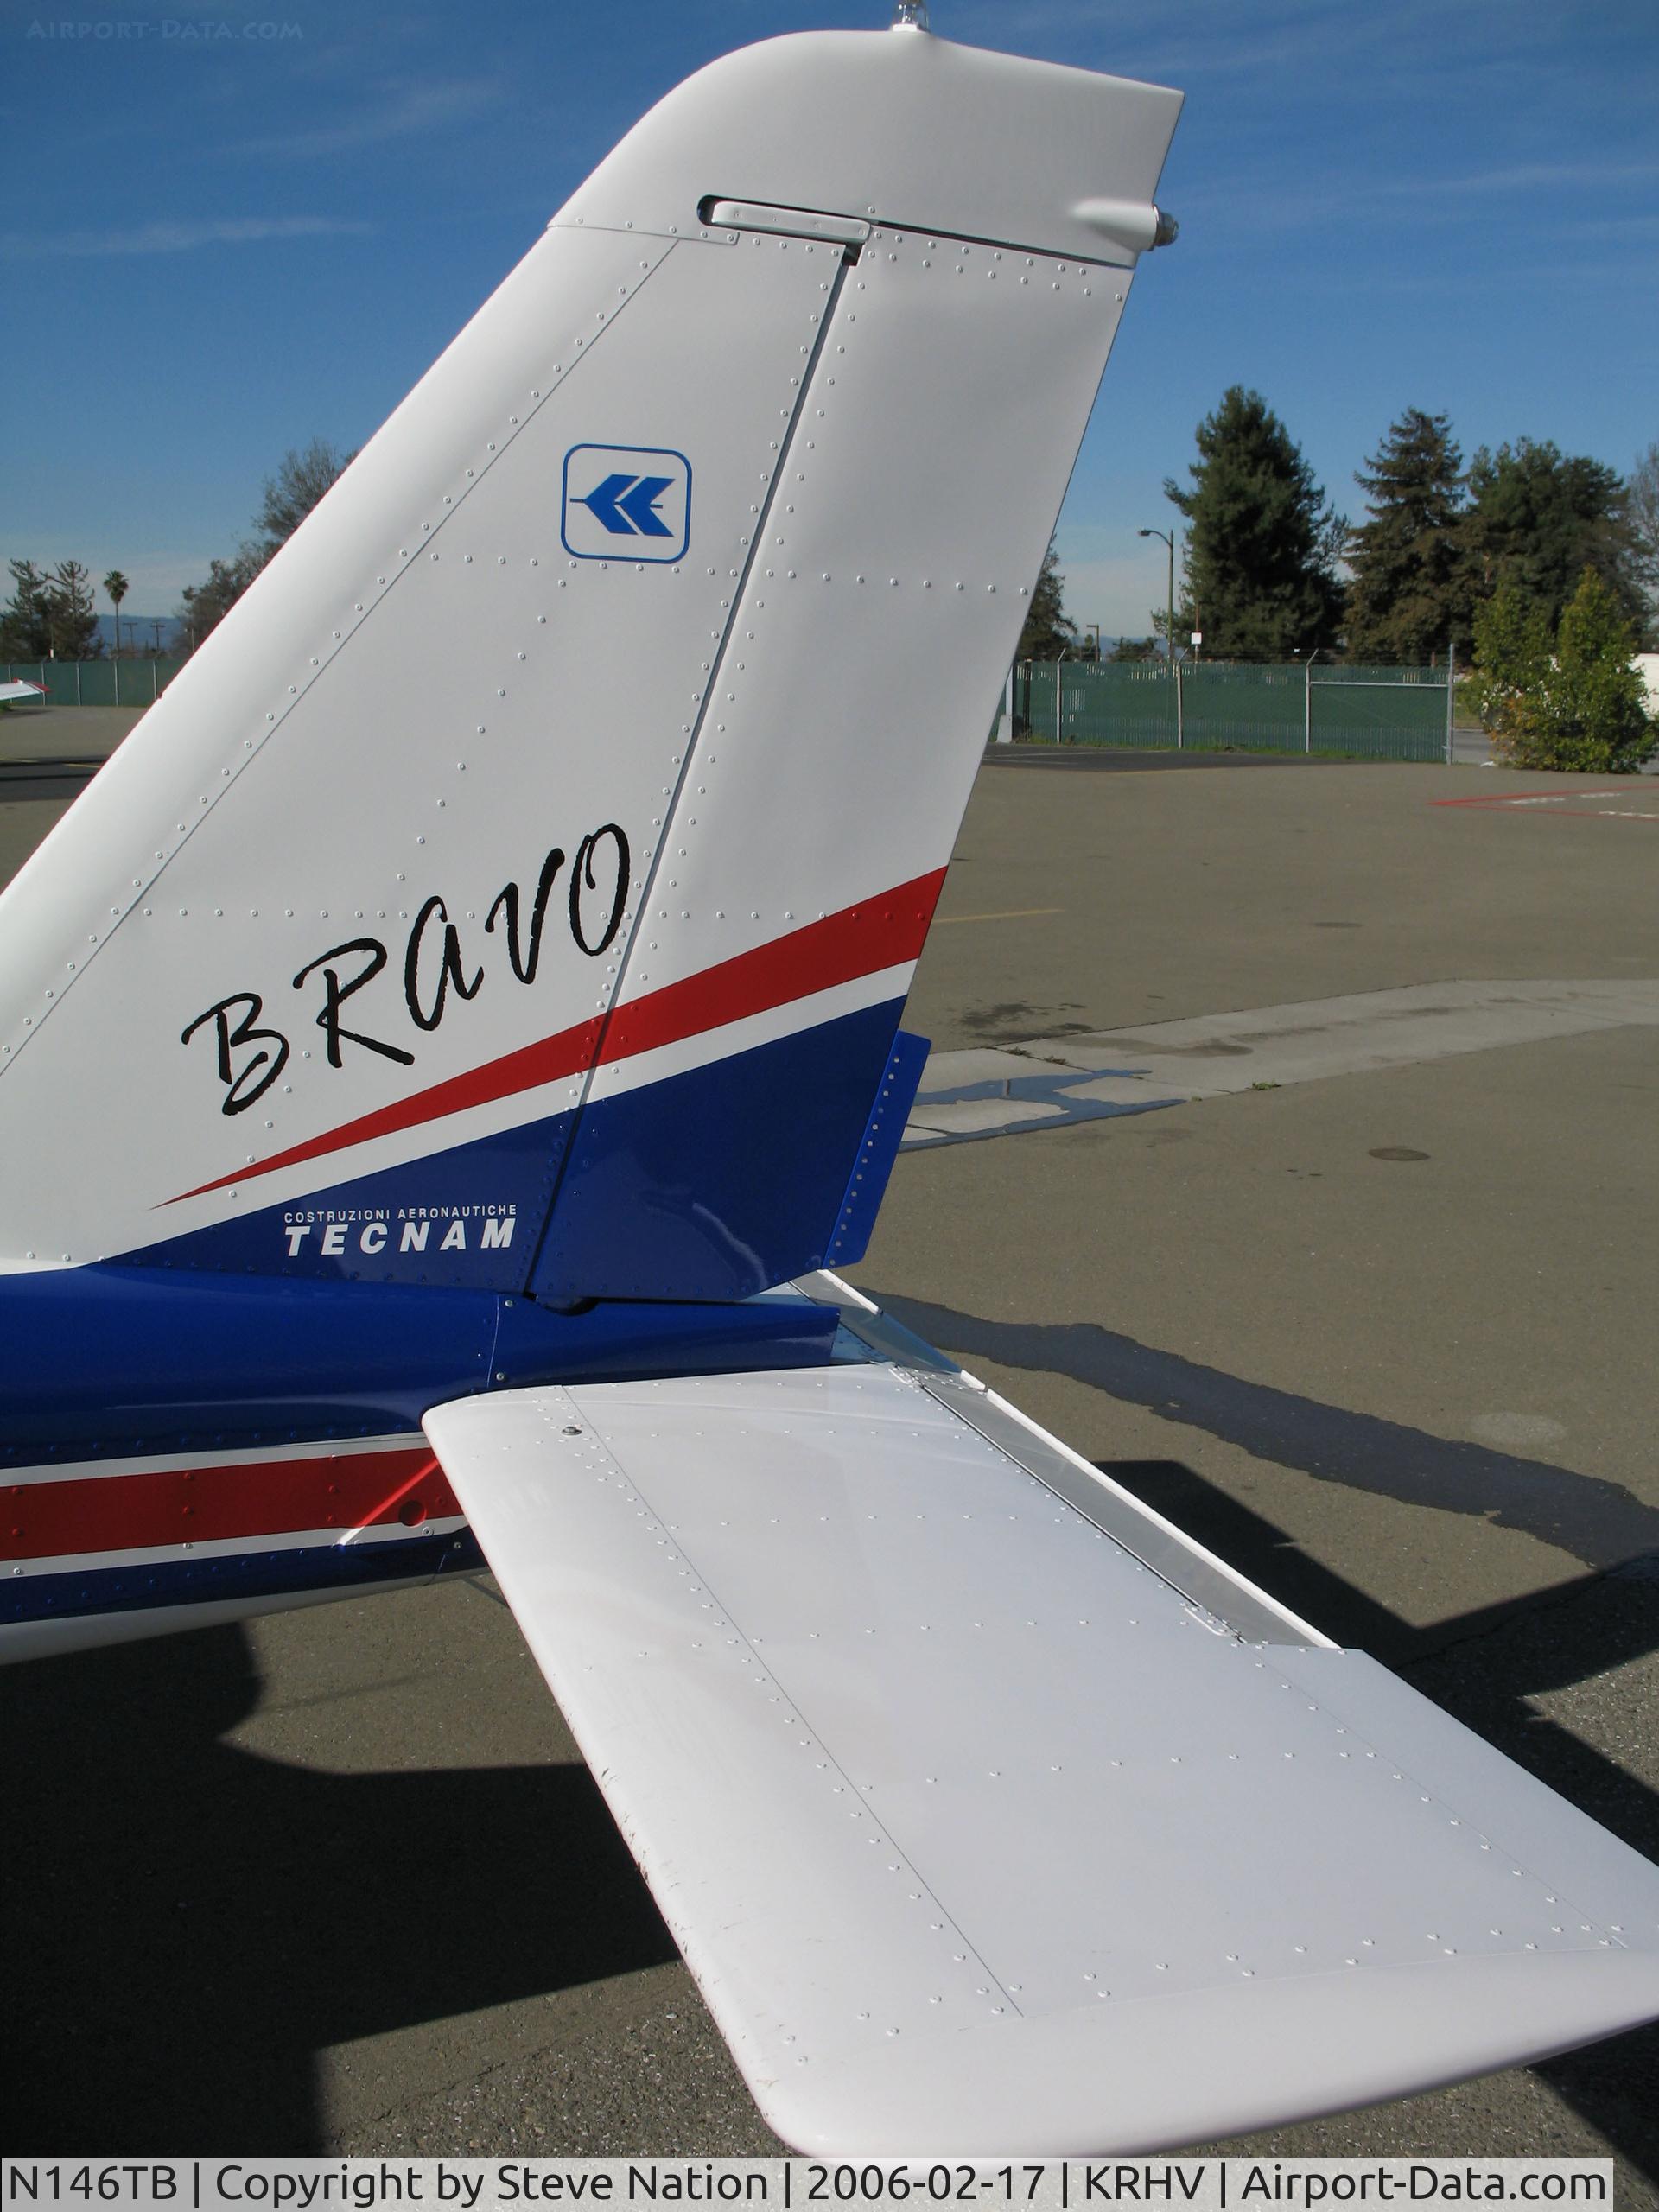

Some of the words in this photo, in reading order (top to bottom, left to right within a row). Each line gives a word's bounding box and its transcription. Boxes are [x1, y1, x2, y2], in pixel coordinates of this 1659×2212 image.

[181, 823, 631, 1116] BRAVO
[284, 1209, 391, 1224] COSTRUZIONI
[397, 1204, 517, 1220] AERONAUTICHE
[284, 1217, 517, 1257] TECNAM
